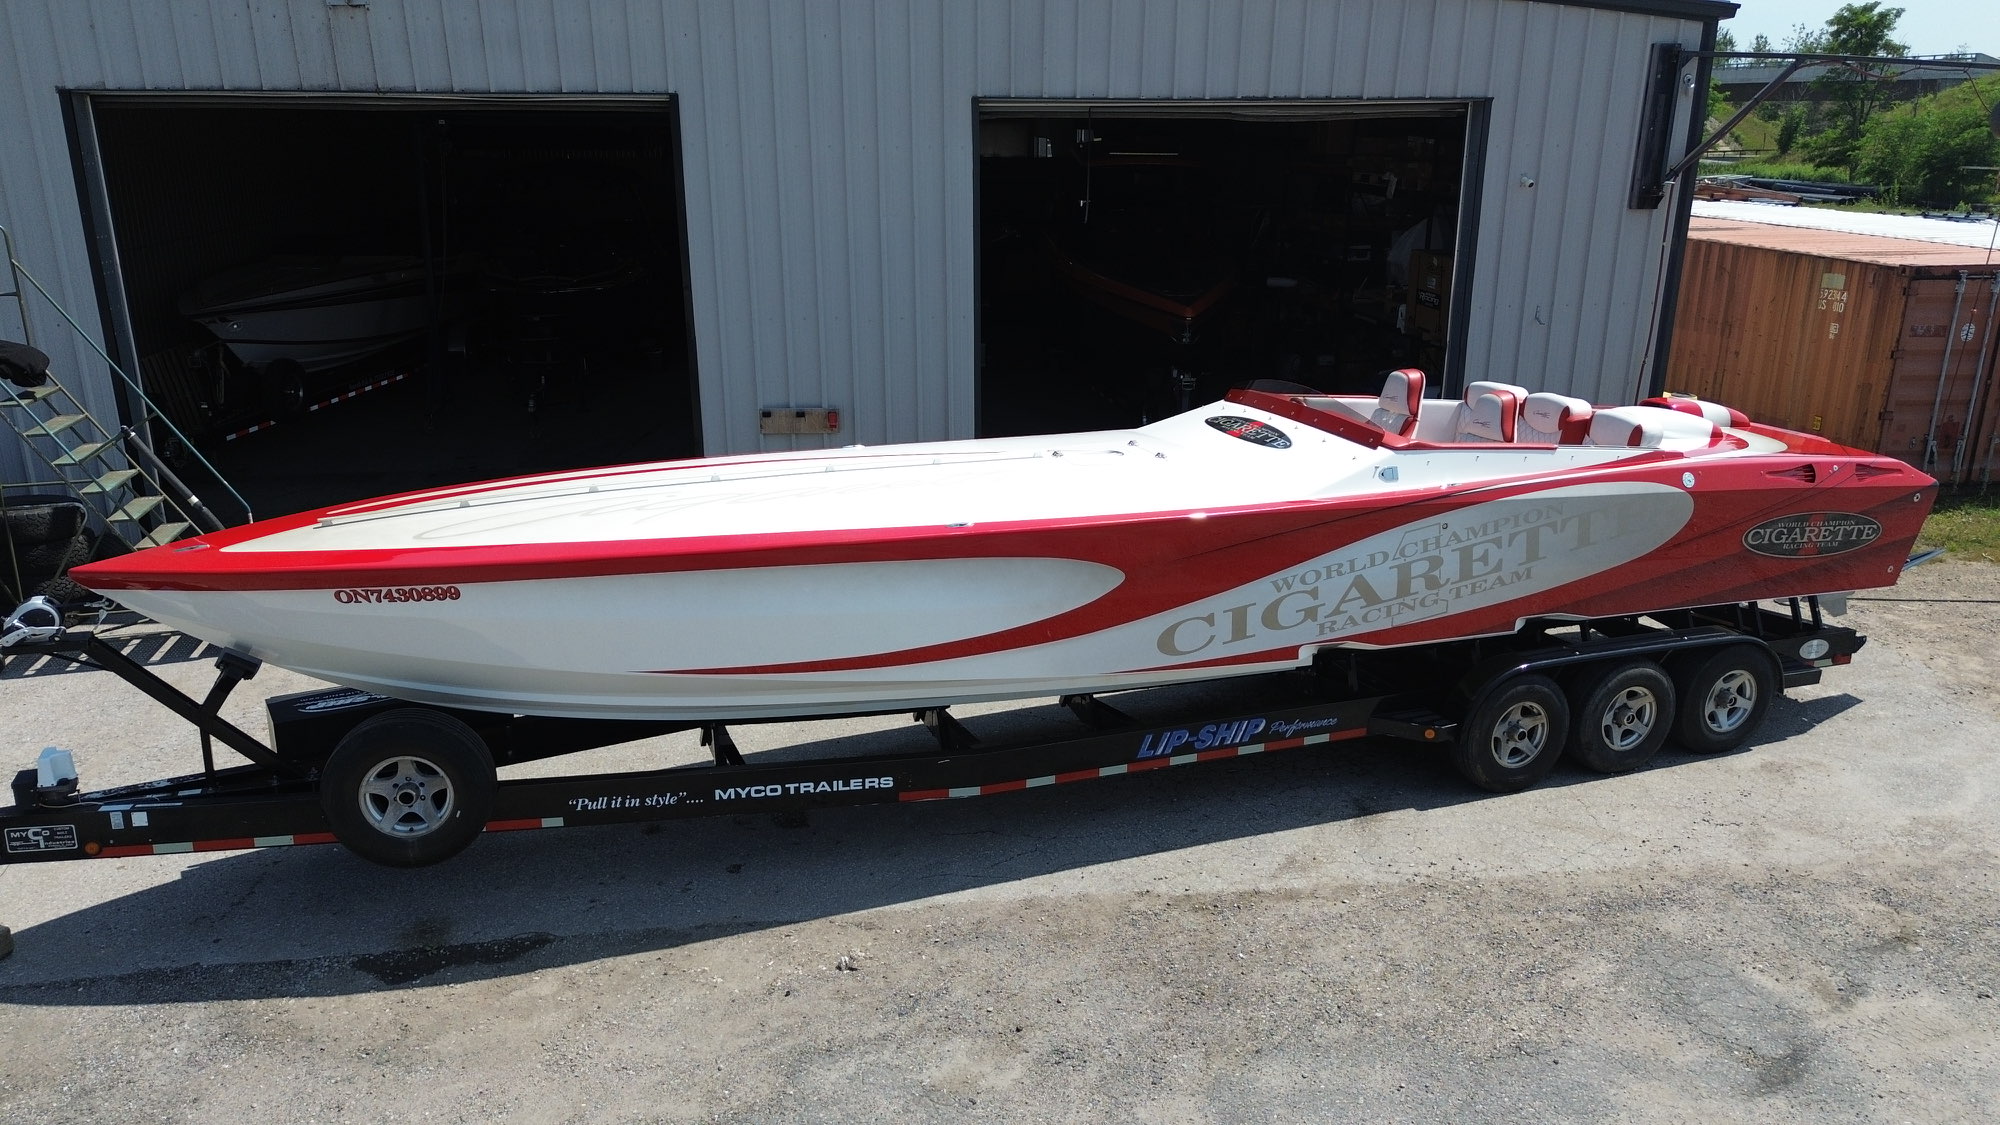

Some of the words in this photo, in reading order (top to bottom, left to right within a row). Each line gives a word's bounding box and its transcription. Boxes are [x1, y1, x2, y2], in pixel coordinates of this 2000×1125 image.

[1747, 524, 1878, 545] CIGARETTE
[1810, 520, 1856, 528] CHAMPION
[1270, 550, 1390, 593] WORLD
[1400, 503, 1566, 559] CHAMPION
[1782, 542, 1814, 550] RACING
[333, 585, 461, 604] ON7430899
[1316, 592, 1440, 637] RACING
[1449, 565, 1535, 600] TEAM
[1136, 717, 1267, 758] LIP-SHIP
[1269, 716, 1339, 738] Performance
[714, 784, 782, 800] MYCO
[786, 776, 894, 795] TRAILERS
[608, 796, 622, 809] it
[625, 795, 640, 808] in
